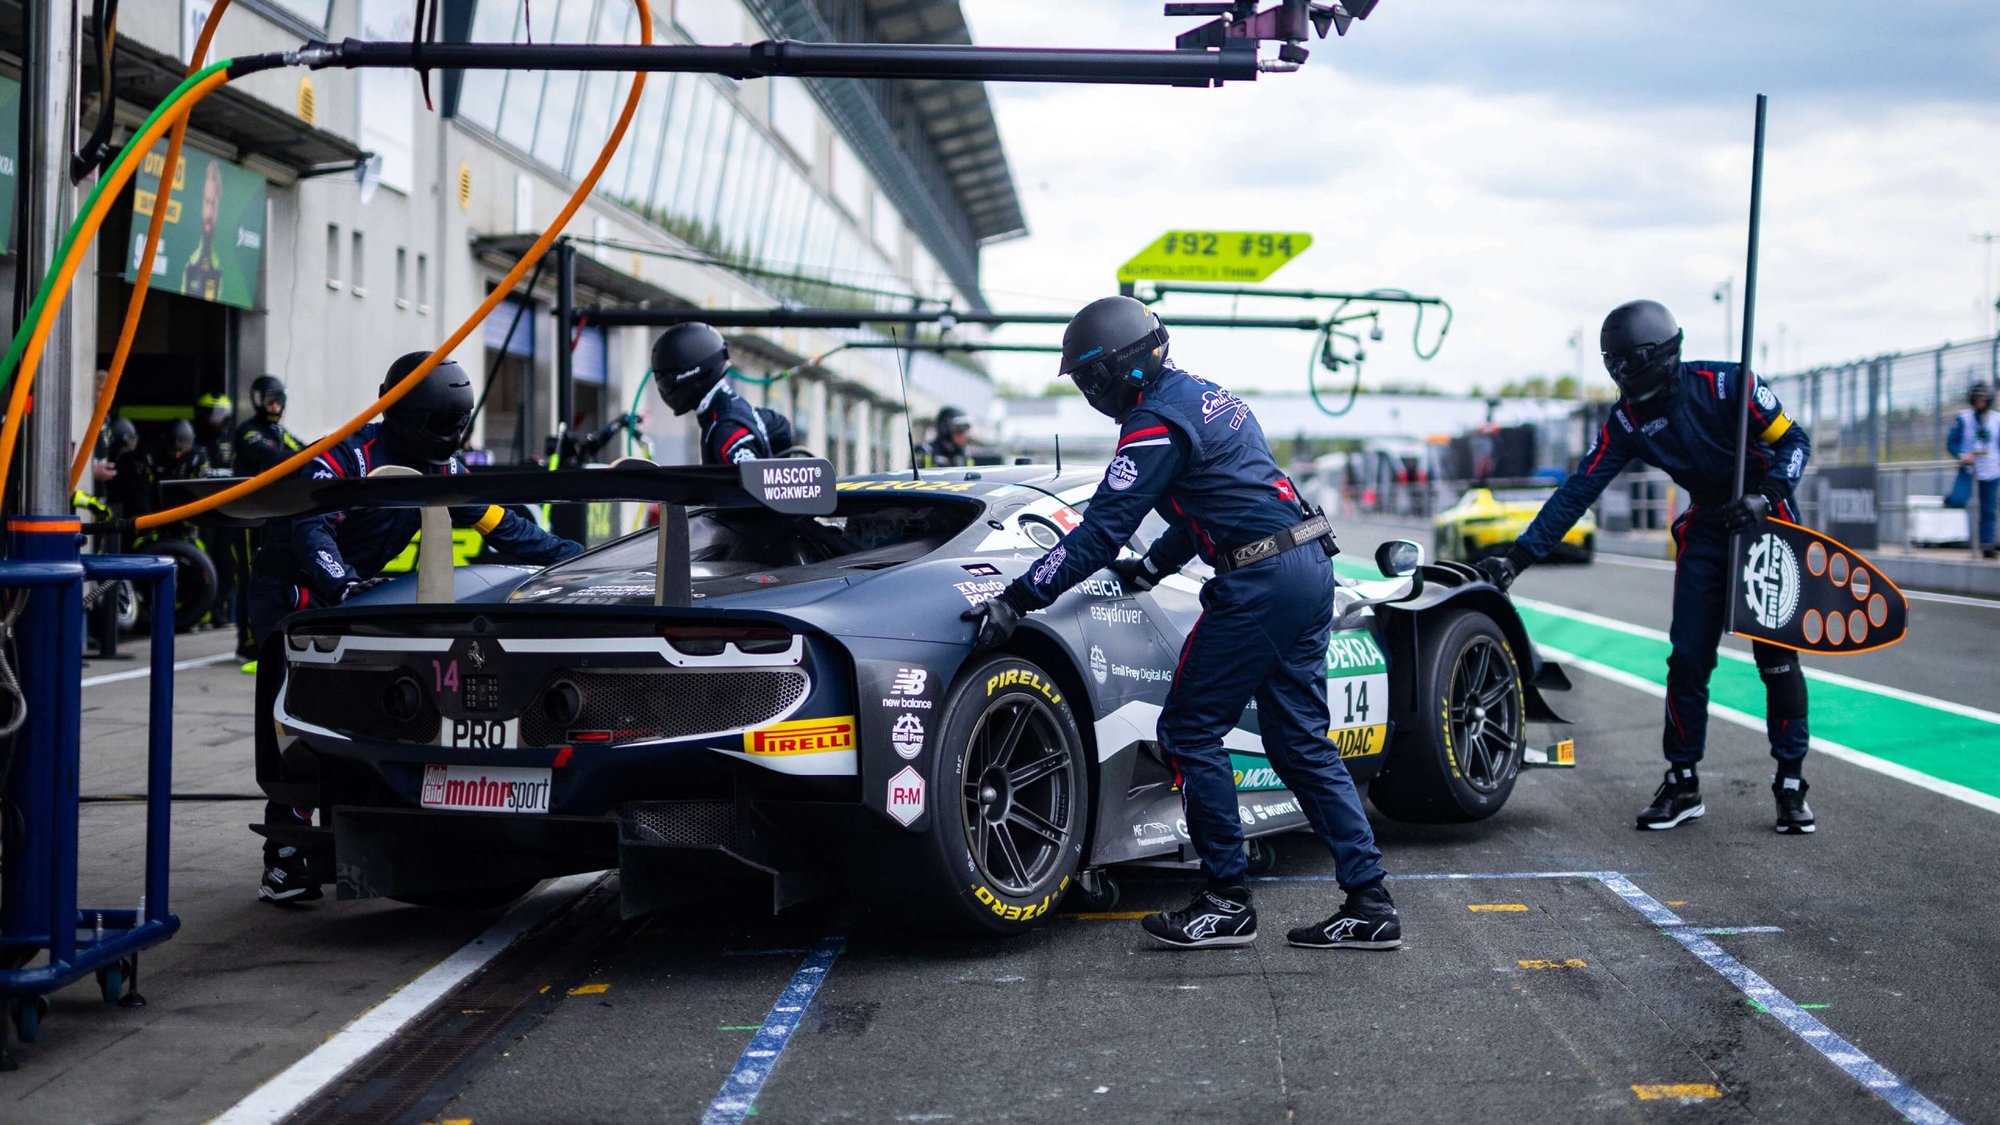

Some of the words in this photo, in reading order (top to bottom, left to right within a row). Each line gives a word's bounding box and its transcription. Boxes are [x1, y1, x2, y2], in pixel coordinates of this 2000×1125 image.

[1165, 233, 1219, 256] #92
[1239, 234, 1294, 257] #94
[866, 480, 977, 492] 2024
[1769, 533, 1784, 580] Frey
[1080, 579, 1123, 597] REICH
[1090, 603, 1143, 627] easydriver
[1766, 582, 1779, 630] Emil
[1326, 636, 1385, 670] DEKRA
[432, 660, 459, 692] 14
[1111, 664, 1126, 677] Emil
[1125, 666, 1140, 681] Frey
[1140, 668, 1161, 682] Digital
[1161, 670, 1172, 682] AG
[986, 669, 1062, 704] PIRELLI
[882, 698, 900, 708] new
[901, 698, 932, 709] balance
[1344, 680, 1369, 723] 14
[453, 720, 506, 749] PRO
[753, 724, 852, 752] PIRELLI
[892, 732, 909, 742] Emil
[909, 732, 924, 745] Frey
[425, 766, 447, 785] Auto
[424, 784, 445, 802] Bild
[892, 787, 921, 805] R-M
